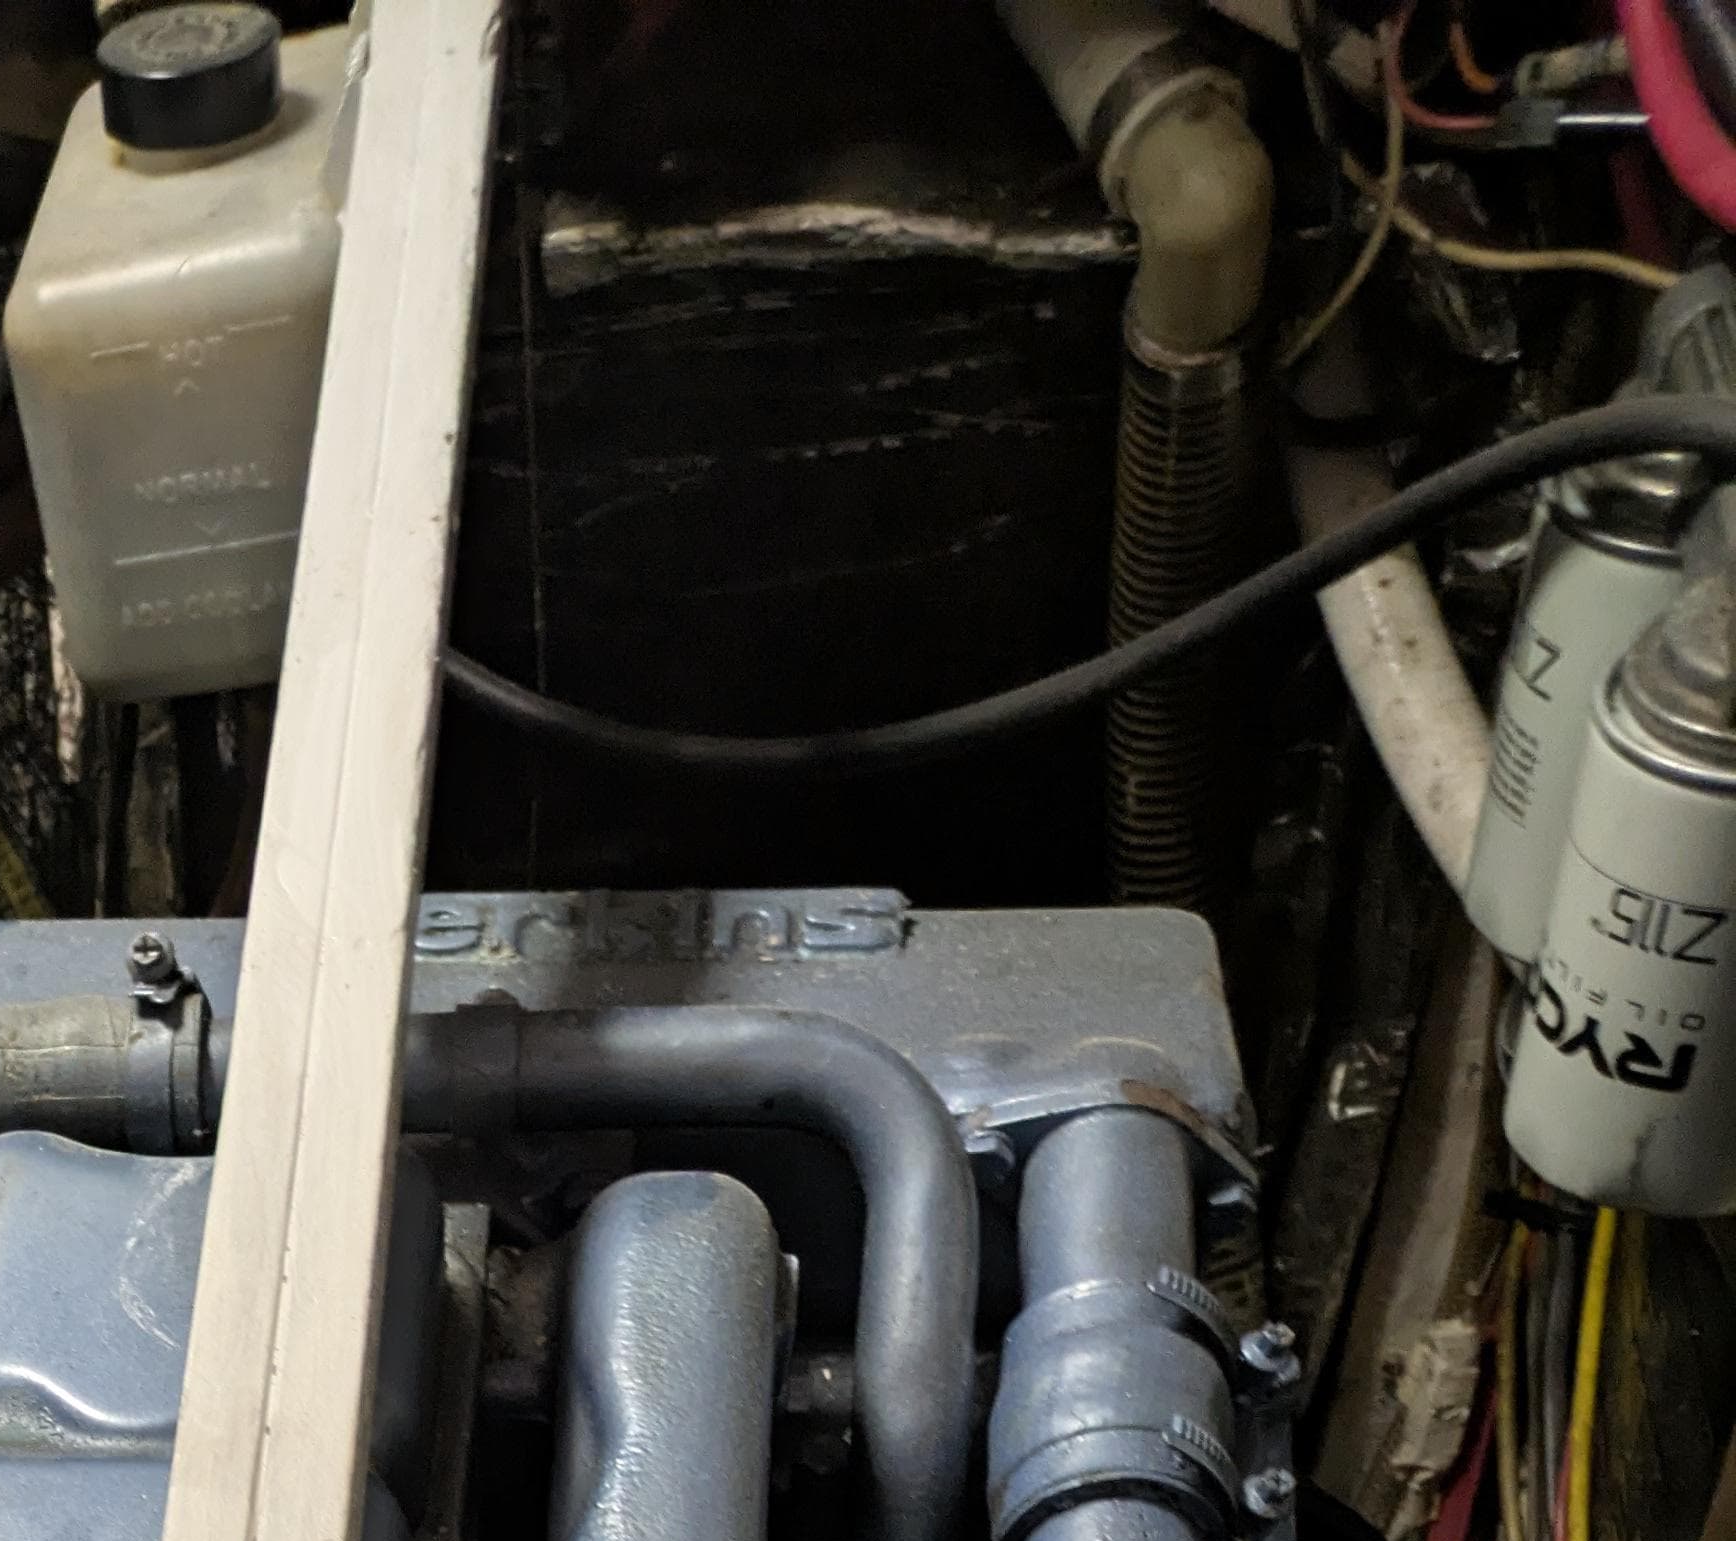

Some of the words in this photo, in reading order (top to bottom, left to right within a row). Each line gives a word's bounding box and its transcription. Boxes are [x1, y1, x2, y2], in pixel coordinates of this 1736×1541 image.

[159, 336, 225, 368] HOT
[414, 892, 906, 958] erkins
[1589, 886, 1728, 966] Z115
[1528, 966, 1699, 1092] RYC
